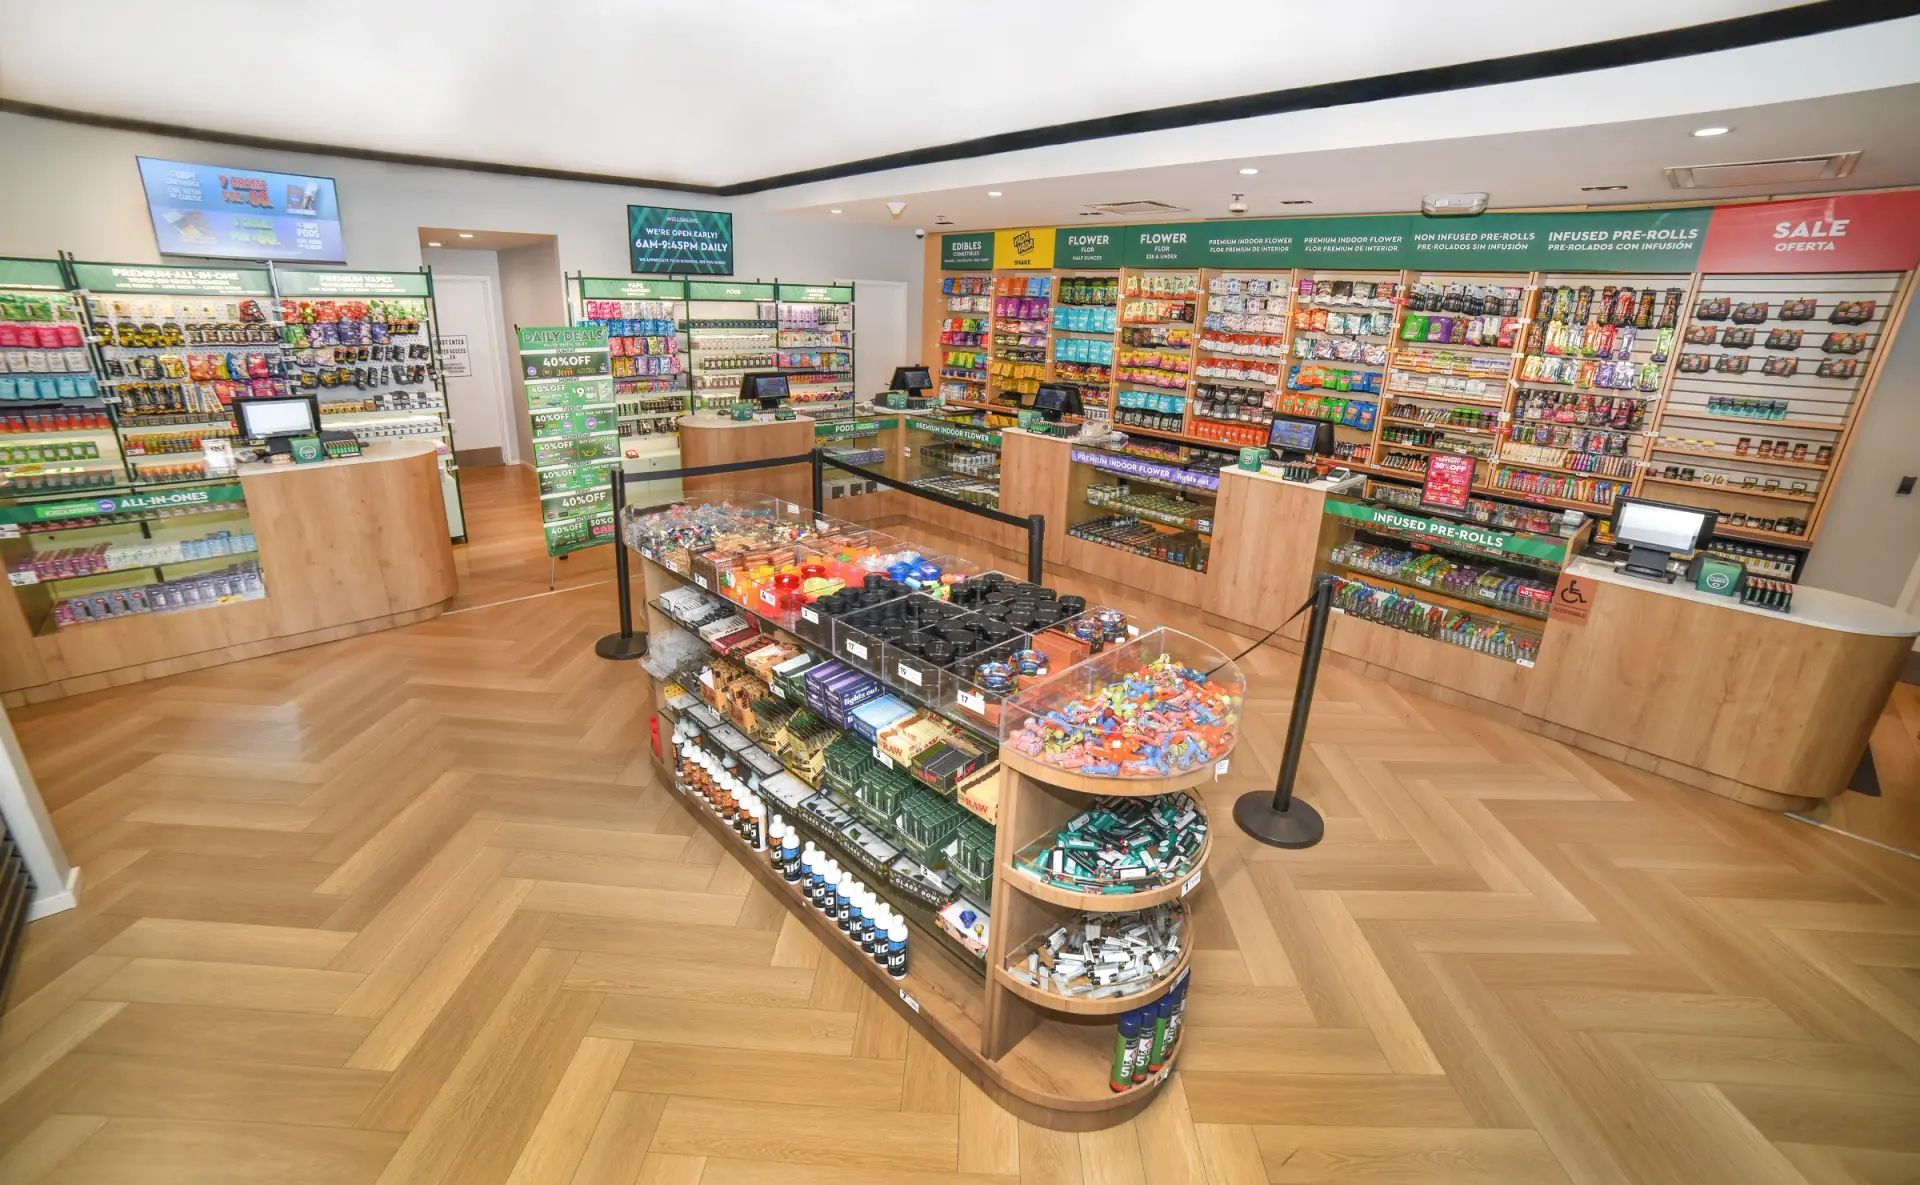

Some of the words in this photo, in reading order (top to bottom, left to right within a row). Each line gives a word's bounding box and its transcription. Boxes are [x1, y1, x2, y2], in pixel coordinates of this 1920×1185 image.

[297, 229, 320, 238] PODS
[672, 229, 692, 237] OPEN
[693, 231, 718, 239] EARLY!
[1548, 231, 1609, 241] INFUSED
[1612, 228, 1699, 241] PRE-ROLLS
[1773, 219, 1851, 239] SALE
[1068, 235, 1109, 245] FLOWER
[1140, 233, 1187, 244] FLOWER
[1414, 233, 1435, 241] NON
[1437, 233, 1478, 241] INFUSED
[1480, 232, 1536, 240] PRE-ROLLS
[635, 239, 698, 250] 6AM-9:45PM
[701, 243, 728, 252] DAILY
[952, 241, 982, 251] EDIBLES
[1488, 241, 1529, 250] INFUSIÓN
[1548, 243, 1614, 251] PRE-ROLADOS
[1641, 240, 1693, 250] INFUSIÓN
[1775, 241, 1836, 251] OFERTA
[523, 330, 561, 344] DAILY
[564, 330, 604, 342] DEALS
[543, 356, 591, 367] 40%OFF
[531, 384, 567, 393] 40%OFF
[535, 413, 570, 422] 40%OFF
[836, 424, 855, 432] PODS
[916, 422, 940, 433] PREMIUM
[941, 426, 964, 437] INDOOR
[964, 431, 989, 442] FLOWER
[539, 441, 573, 450] 40%OFF
[542, 469, 577, 479] 40%OFF
[1077, 453, 1108, 466] PREMIUM
[1109, 458, 1137, 471] INDOOR
[1139, 465, 1170, 478] FLOWER
[1177, 473, 1197, 484] lights
[120, 491, 208, 508] ALL-IN-ONES
[562, 492, 606, 507] 40%OFF
[551, 523, 583, 534] 40%OFF
[591, 517, 614, 525] 50%O
[1374, 512, 1426, 531] INFUSED
[1430, 523, 1504, 547] PRE-ROLLS
[761, 591, 767, 599] 4
[1553, 606, 1586, 618] ACCESSIBLE
[848, 642, 855, 650] 17
[900, 667, 907, 676] 19
[844, 692, 866, 706] lights
[866, 686, 880, 697] out.
[961, 694, 969, 703] 17
[875, 750, 881, 758] 3
[882, 742, 903, 757] RAW
[917, 769, 938, 783] RAW
[965, 798, 989, 813] RAW
[802, 812, 818, 826] GLASS
[820, 823, 836, 836] BOWL
[844, 841, 860, 855] GLASS
[862, 855, 878, 870] BOWL
[922, 867, 928, 876] 3
[895, 877, 917, 892] GLASS
[921, 890, 942, 904] BOWL
[888, 955, 905, 966] 710
